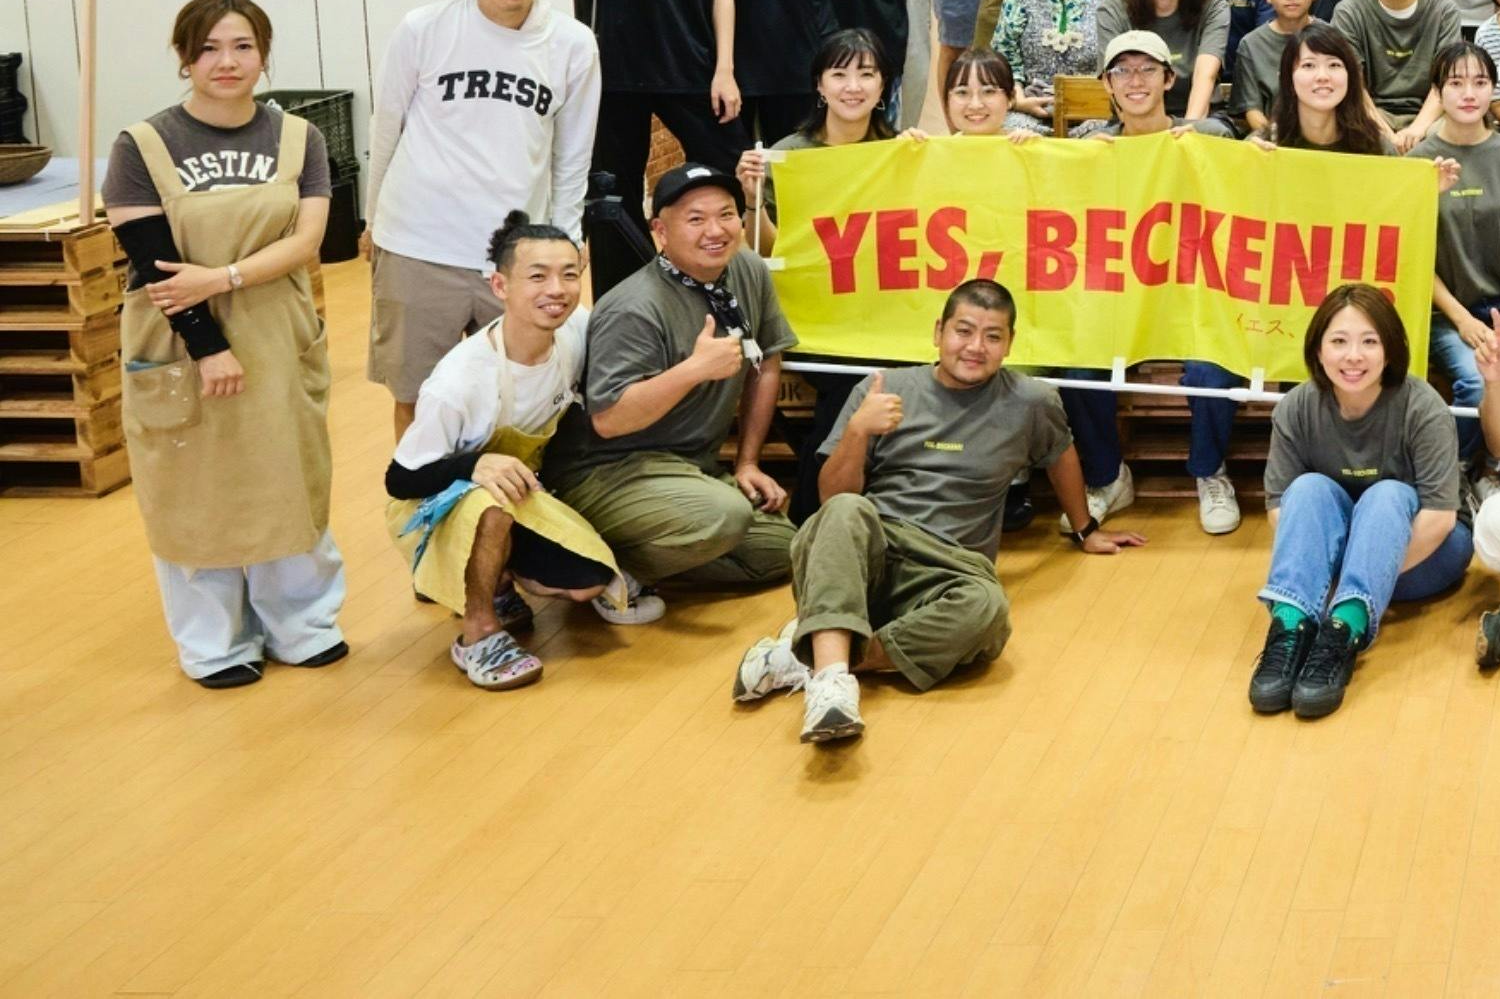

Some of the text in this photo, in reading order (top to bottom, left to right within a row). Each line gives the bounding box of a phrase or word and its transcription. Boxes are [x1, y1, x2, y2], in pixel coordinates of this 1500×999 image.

[176, 150, 278, 192] ESTIN
[812, 202, 1401, 307] YES, BECKEN!!
